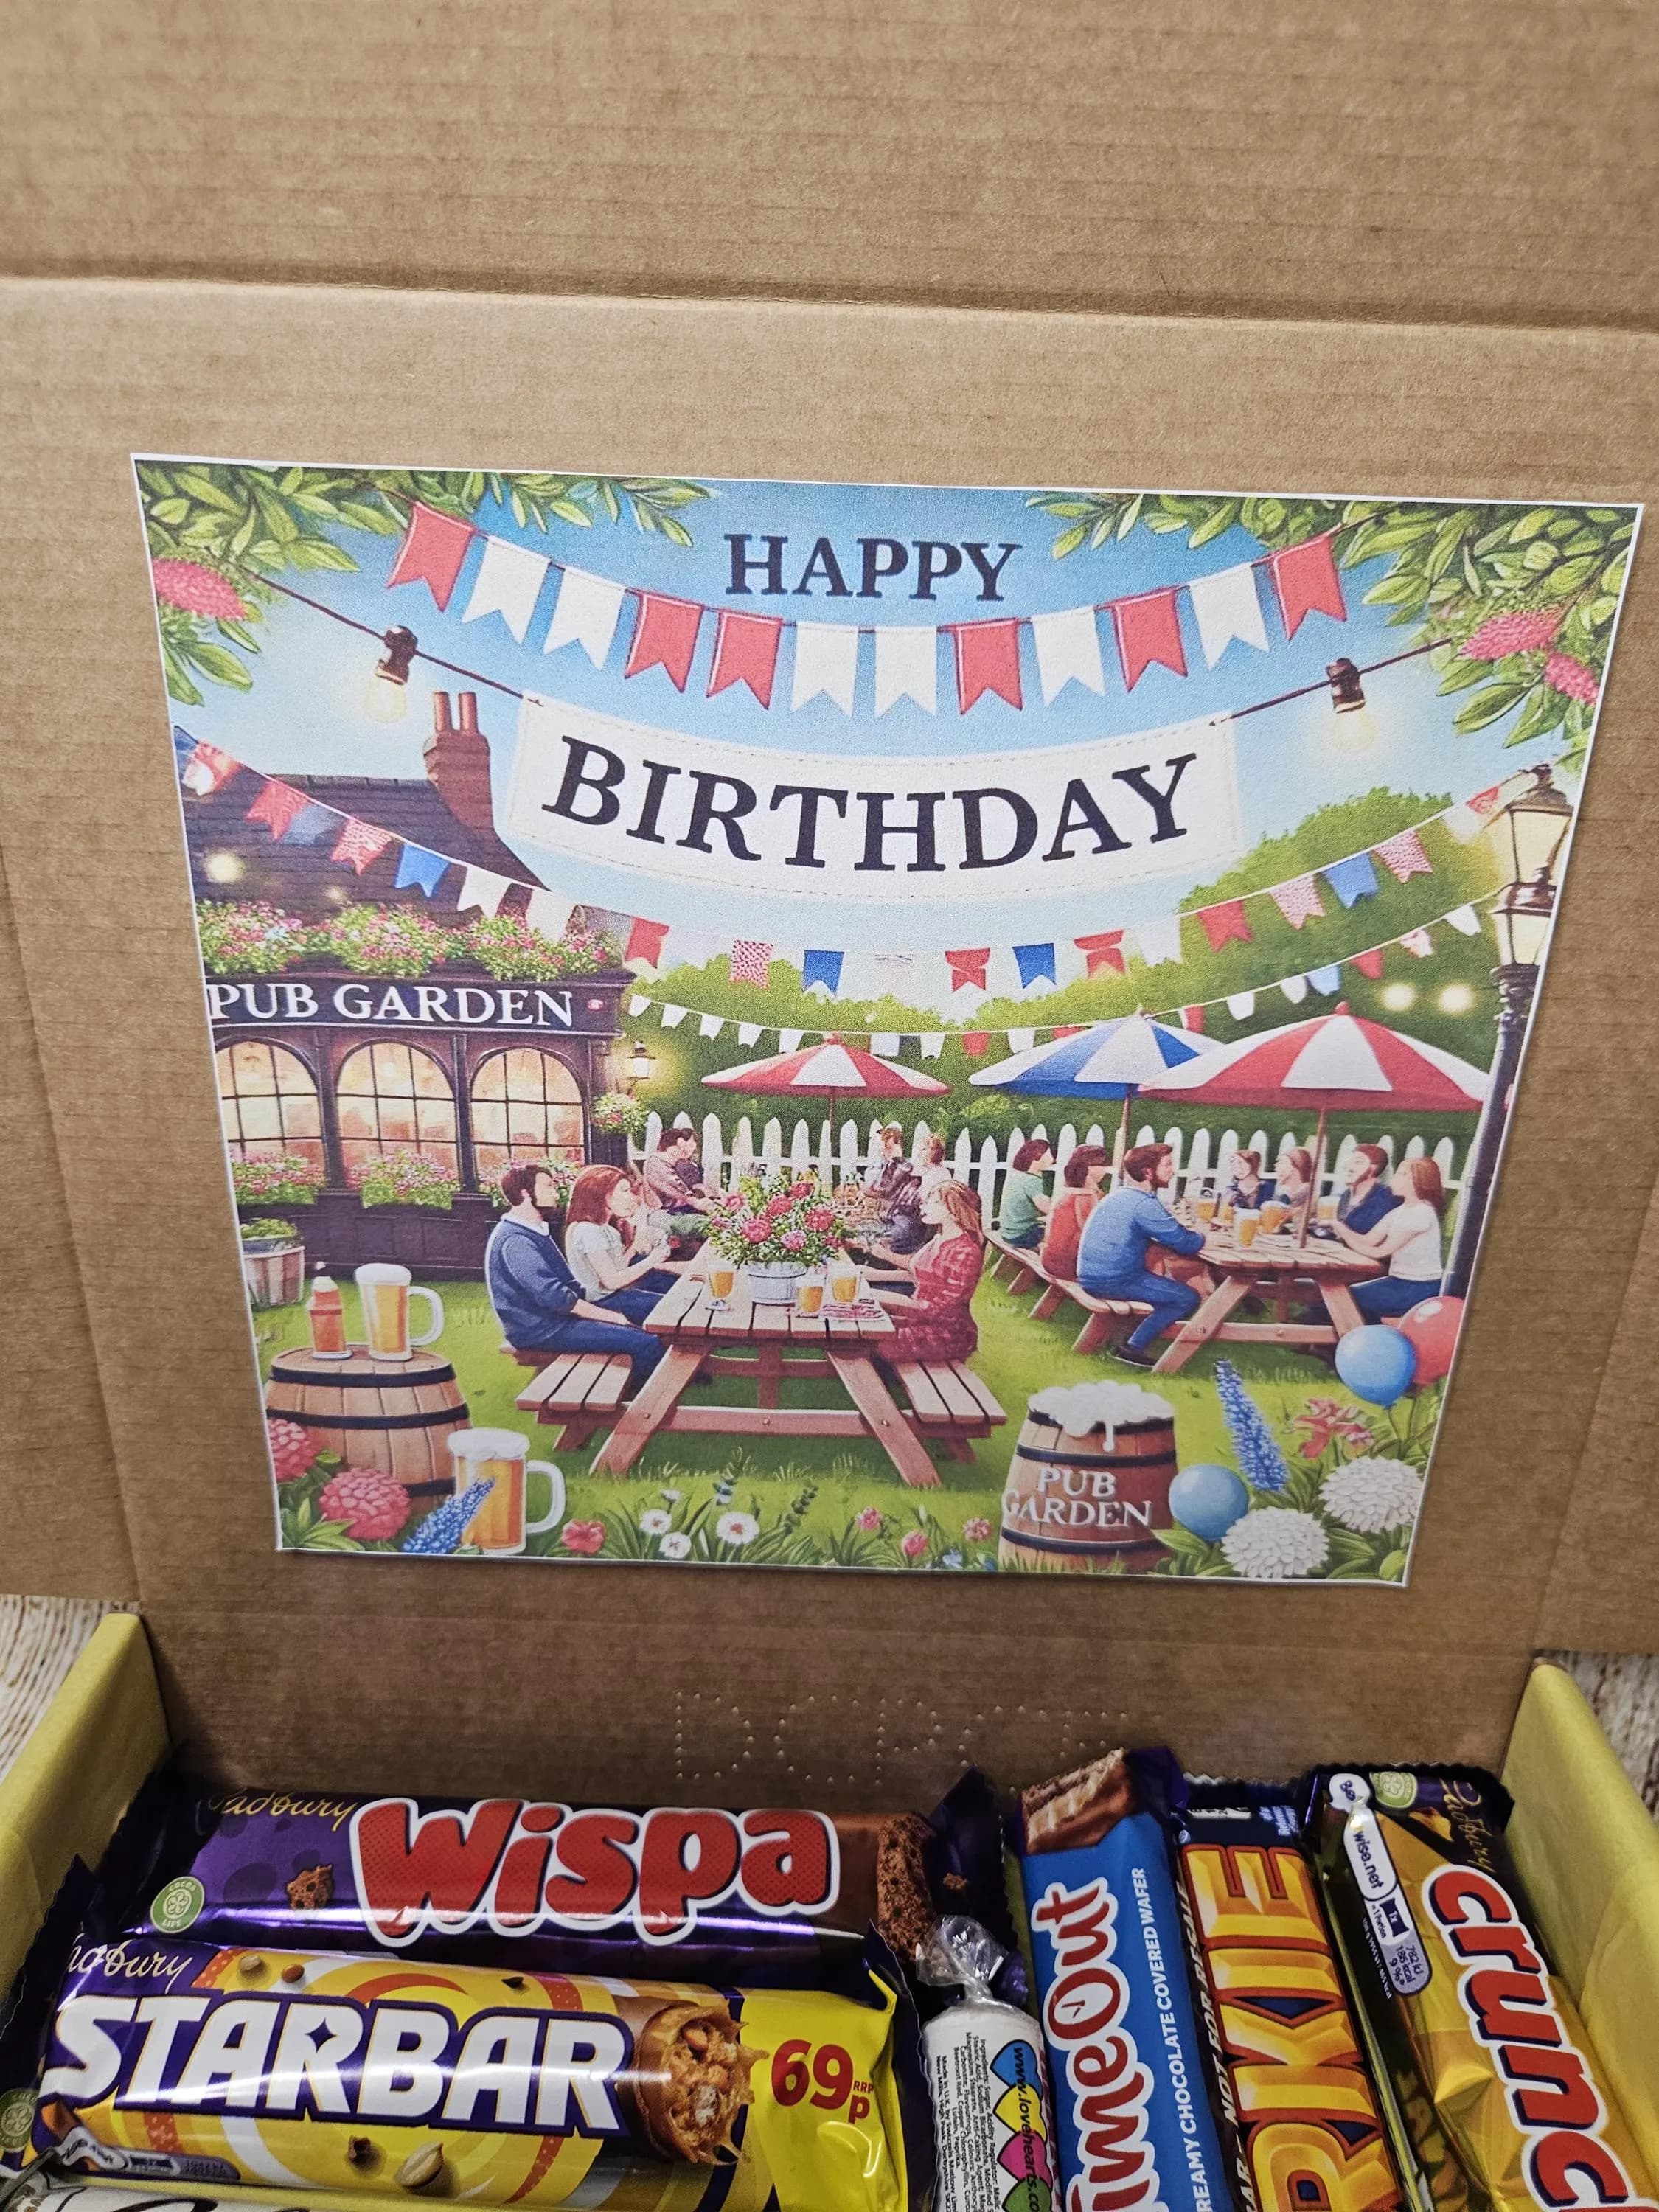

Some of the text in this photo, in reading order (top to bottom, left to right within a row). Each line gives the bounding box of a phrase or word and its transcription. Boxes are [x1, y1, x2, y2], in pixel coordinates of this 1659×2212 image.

[724, 533, 1022, 602] HAPPY
[541, 735, 1197, 873] BIRTHDAY
[206, 984, 574, 1027] PUB GARDEN
[1037, 1467, 1116, 1497] PUB
[1001, 1489, 1153, 1528] GARDEN
[169, 1881, 197, 1891] COCOA
[354, 1798, 839, 1947] Wispa
[1131, 1868, 1154, 1925] WAFER
[161, 1919, 181, 1927] LIFE
[1176, 1881, 1208, 1989] RESALE
[1143, 1926, 1172, 2011] COVERED
[1402, 1963, 1416, 1983] kcal
[1405, 1944, 1419, 1964] 782
[1200, 1991, 1222, 2053] FOR
[39, 1994, 621, 2131] STARBAR
[1037, 1885, 1152, 2212] imeOut
[853, 2081, 874, 2094] RRP
[1159, 2012, 1196, 2134] CHOCOLATE
[1212, 2053, 1239, 2126] NOT
[973, 2115, 981, 2161] Anti-Caking
[987, 2112, 995, 2140] Acidity
[985, 2168, 993, 2205] Modified
[989, 2143, 998, 2184] Regulator:
